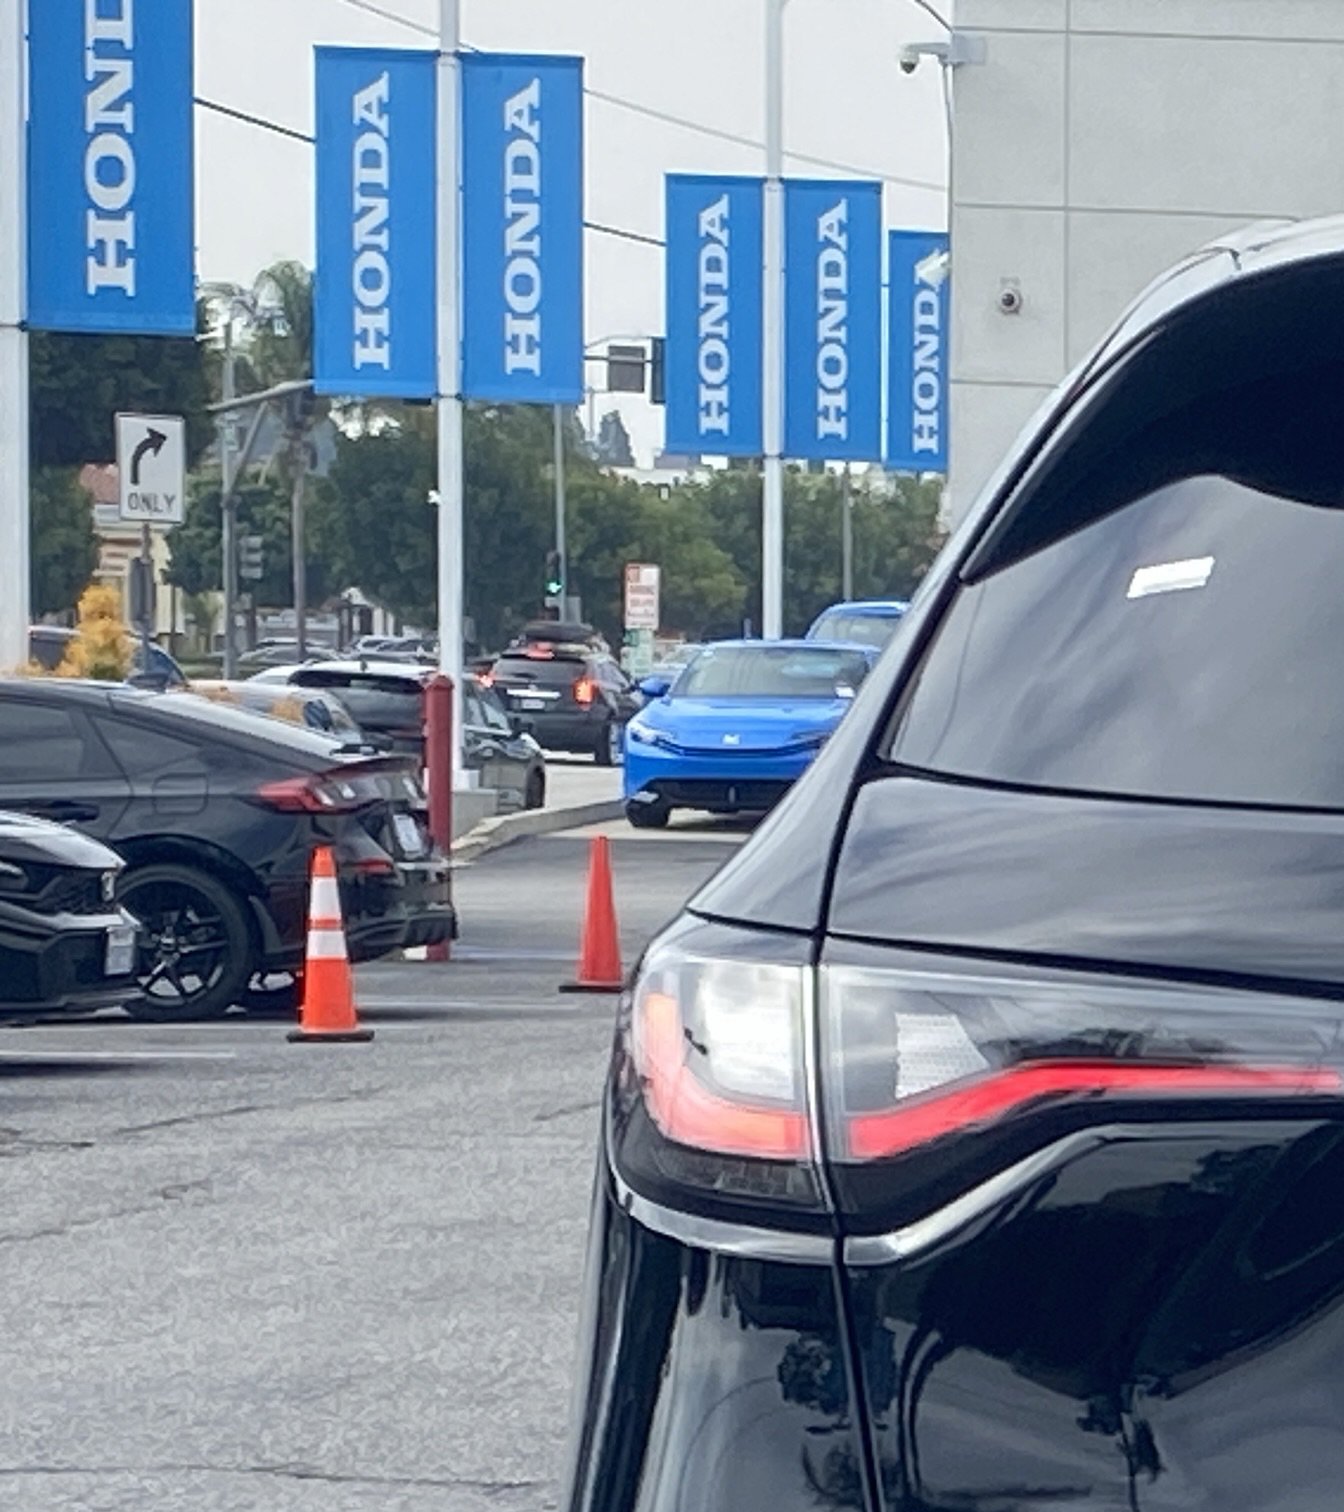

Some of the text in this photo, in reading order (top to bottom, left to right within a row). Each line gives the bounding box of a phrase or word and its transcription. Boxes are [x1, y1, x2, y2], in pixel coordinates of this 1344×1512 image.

[351, 70, 391, 371] HONDA
[503, 77, 542, 376] HONDA
[697, 193, 731, 437] HONDA
[816, 198, 849, 441] HONDA
[128, 492, 176, 513] ONLY
